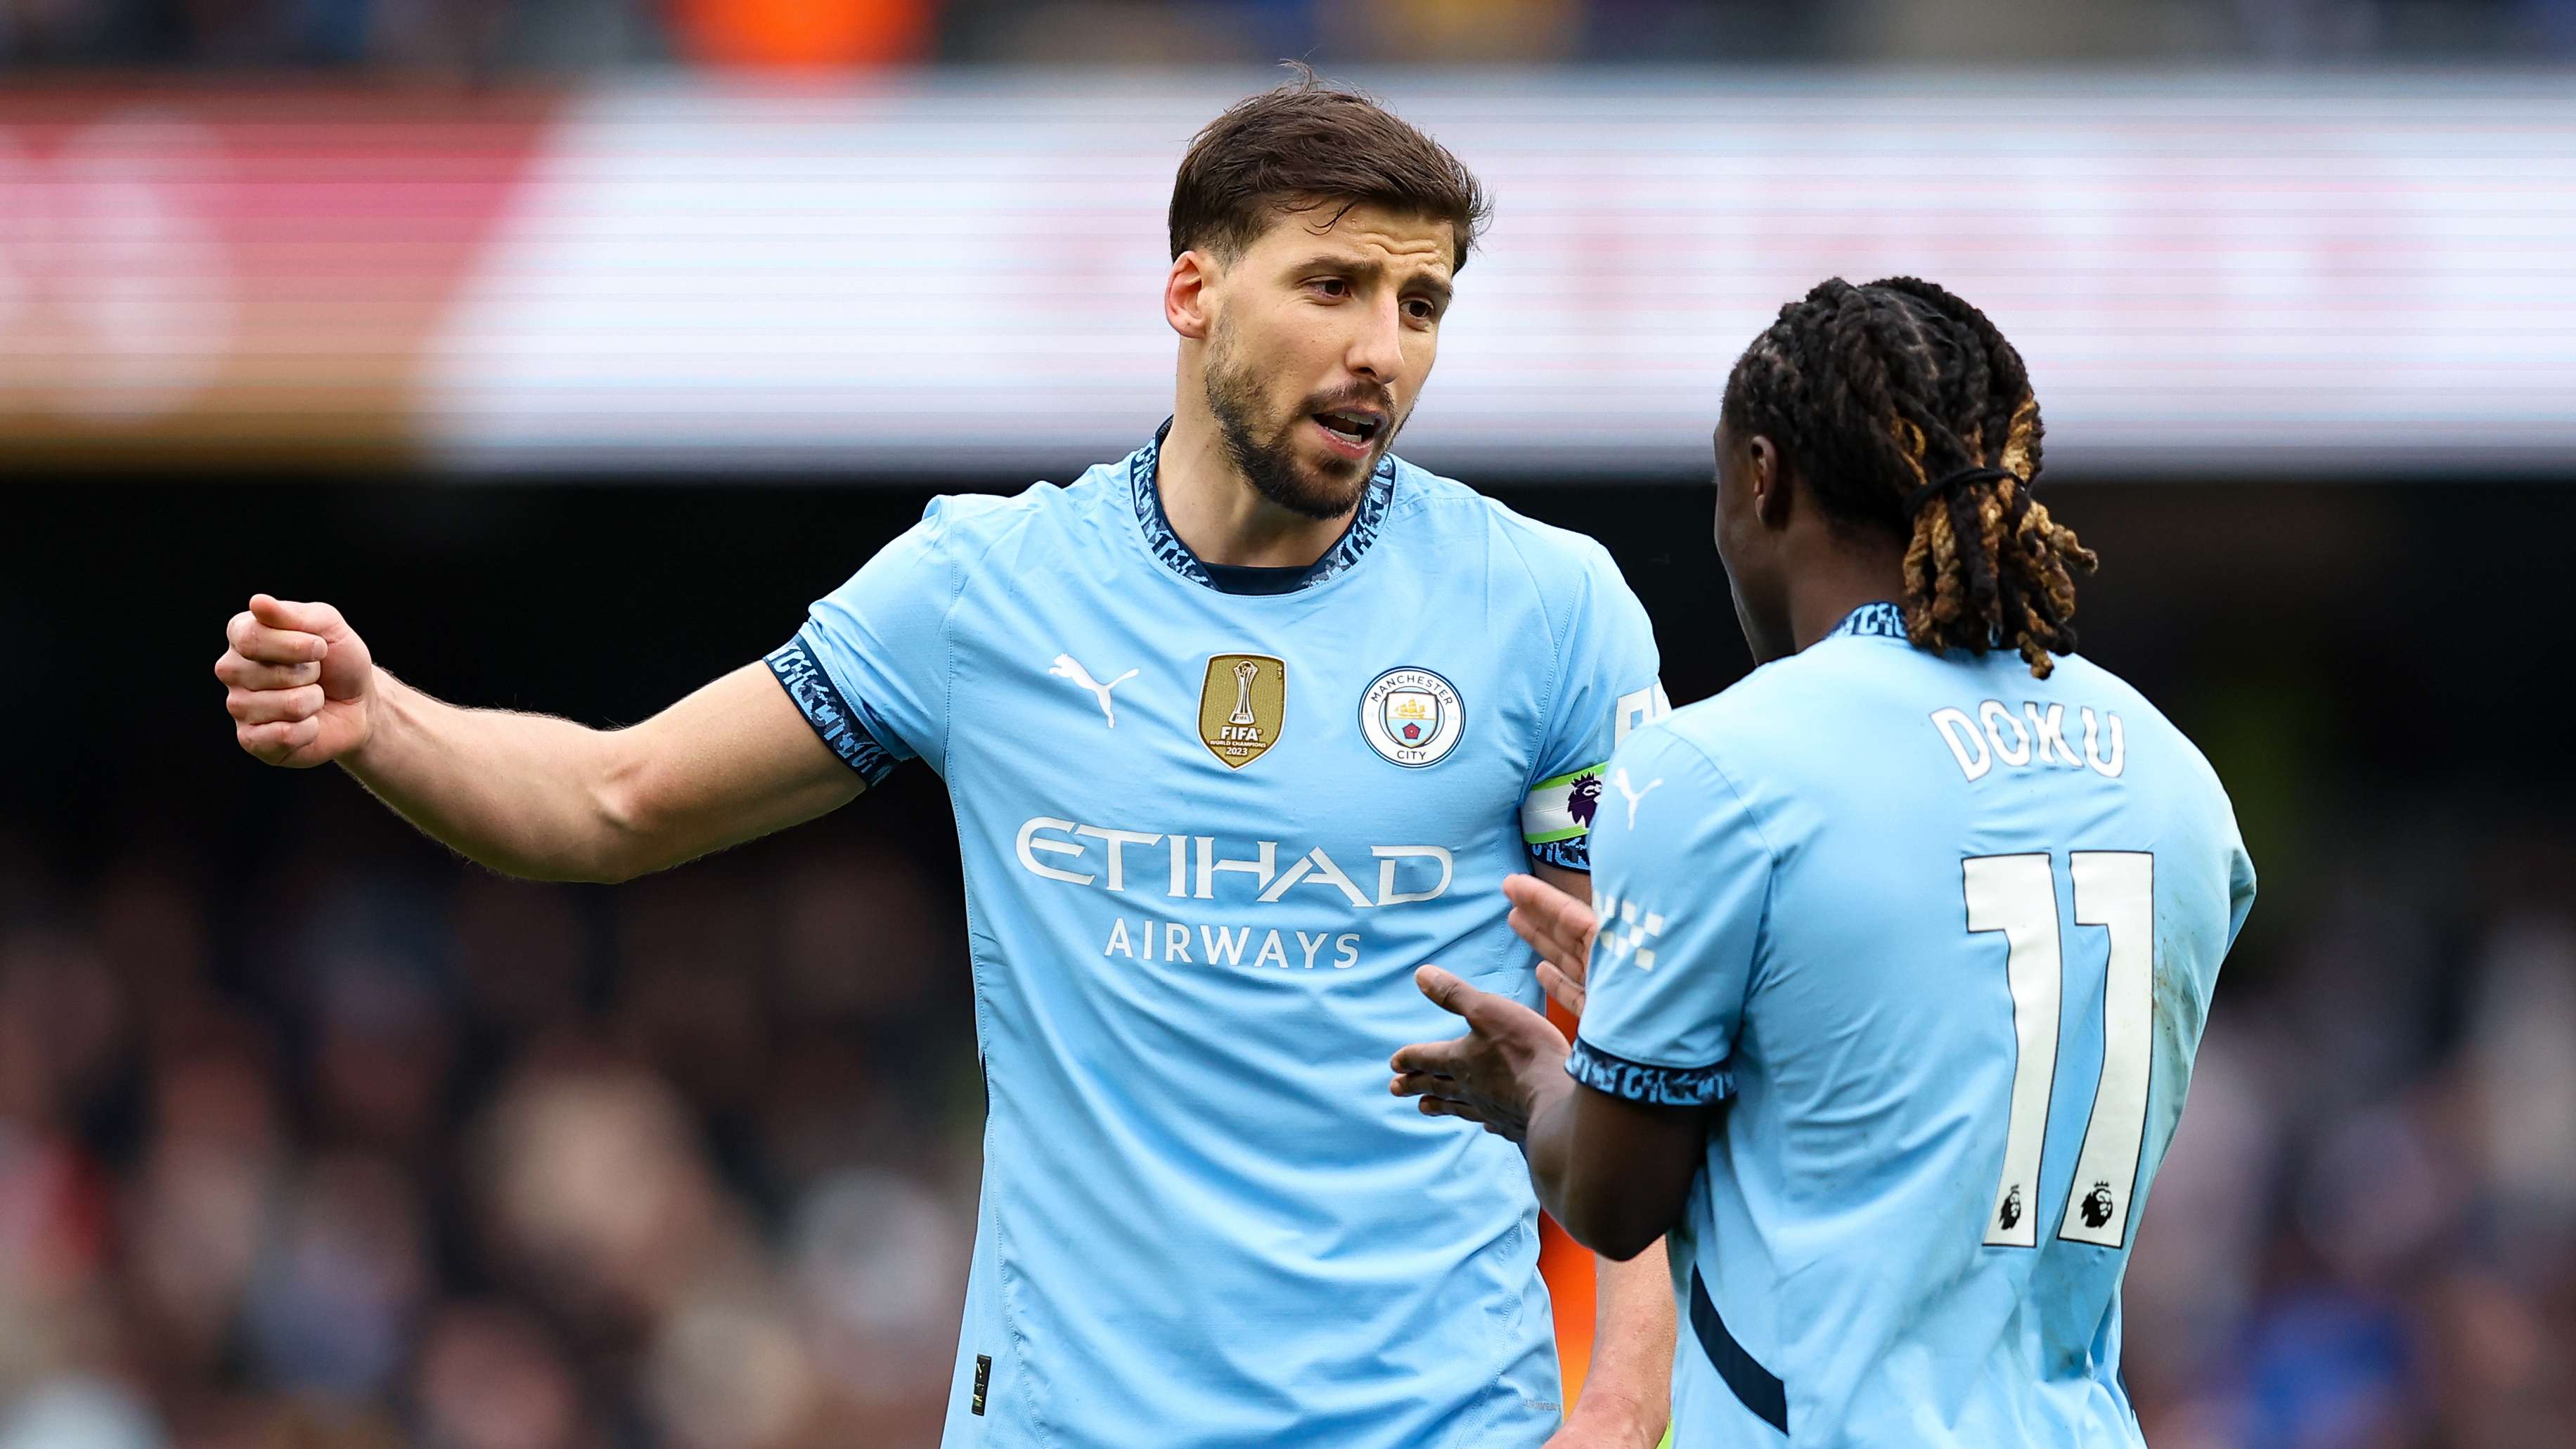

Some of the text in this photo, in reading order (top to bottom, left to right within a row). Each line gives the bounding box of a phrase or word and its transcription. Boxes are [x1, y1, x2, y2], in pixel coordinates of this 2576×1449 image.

[1371, 675, 1453, 705] MANCHESTER
[1221, 726, 1258, 741] FIFA
[1226, 747, 1248, 756] 2023
[1929, 699, 2125, 783] DOKU
[1397, 750, 1427, 760] CITY
[1015, 816, 1453, 908] ETIHAD
[1105, 917, 1361, 970] AIRWAYS
[1962, 850, 2153, 1249] 11
